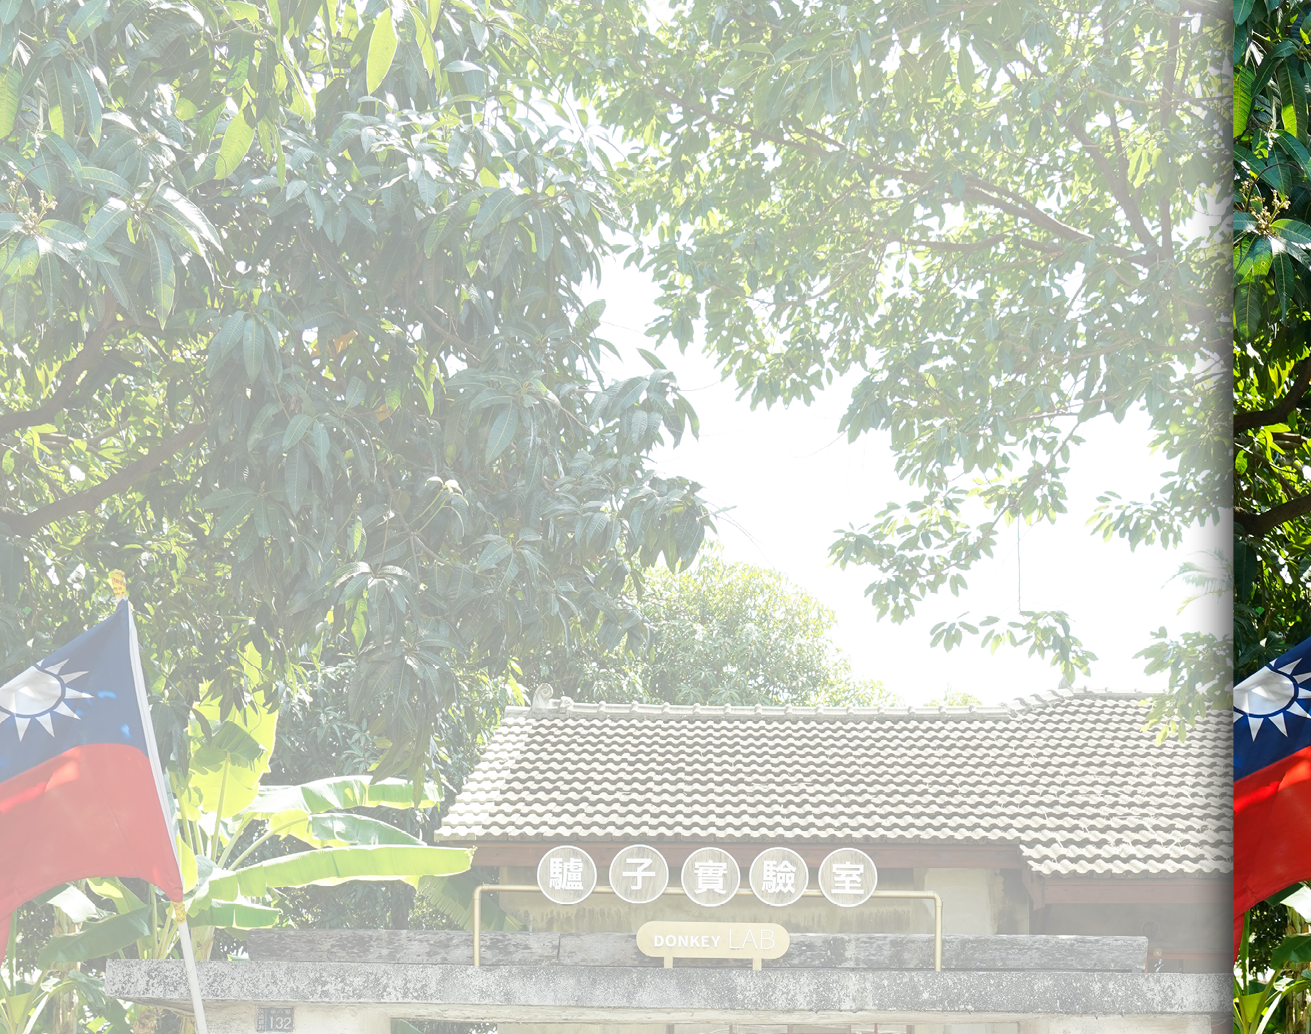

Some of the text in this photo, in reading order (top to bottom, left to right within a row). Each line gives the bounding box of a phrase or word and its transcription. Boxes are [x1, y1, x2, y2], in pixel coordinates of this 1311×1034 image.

[549, 857, 865, 895] 驢子實驗室
[653, 928, 776, 950] DONKEY LAB
[270, 1016, 292, 1030] 132
